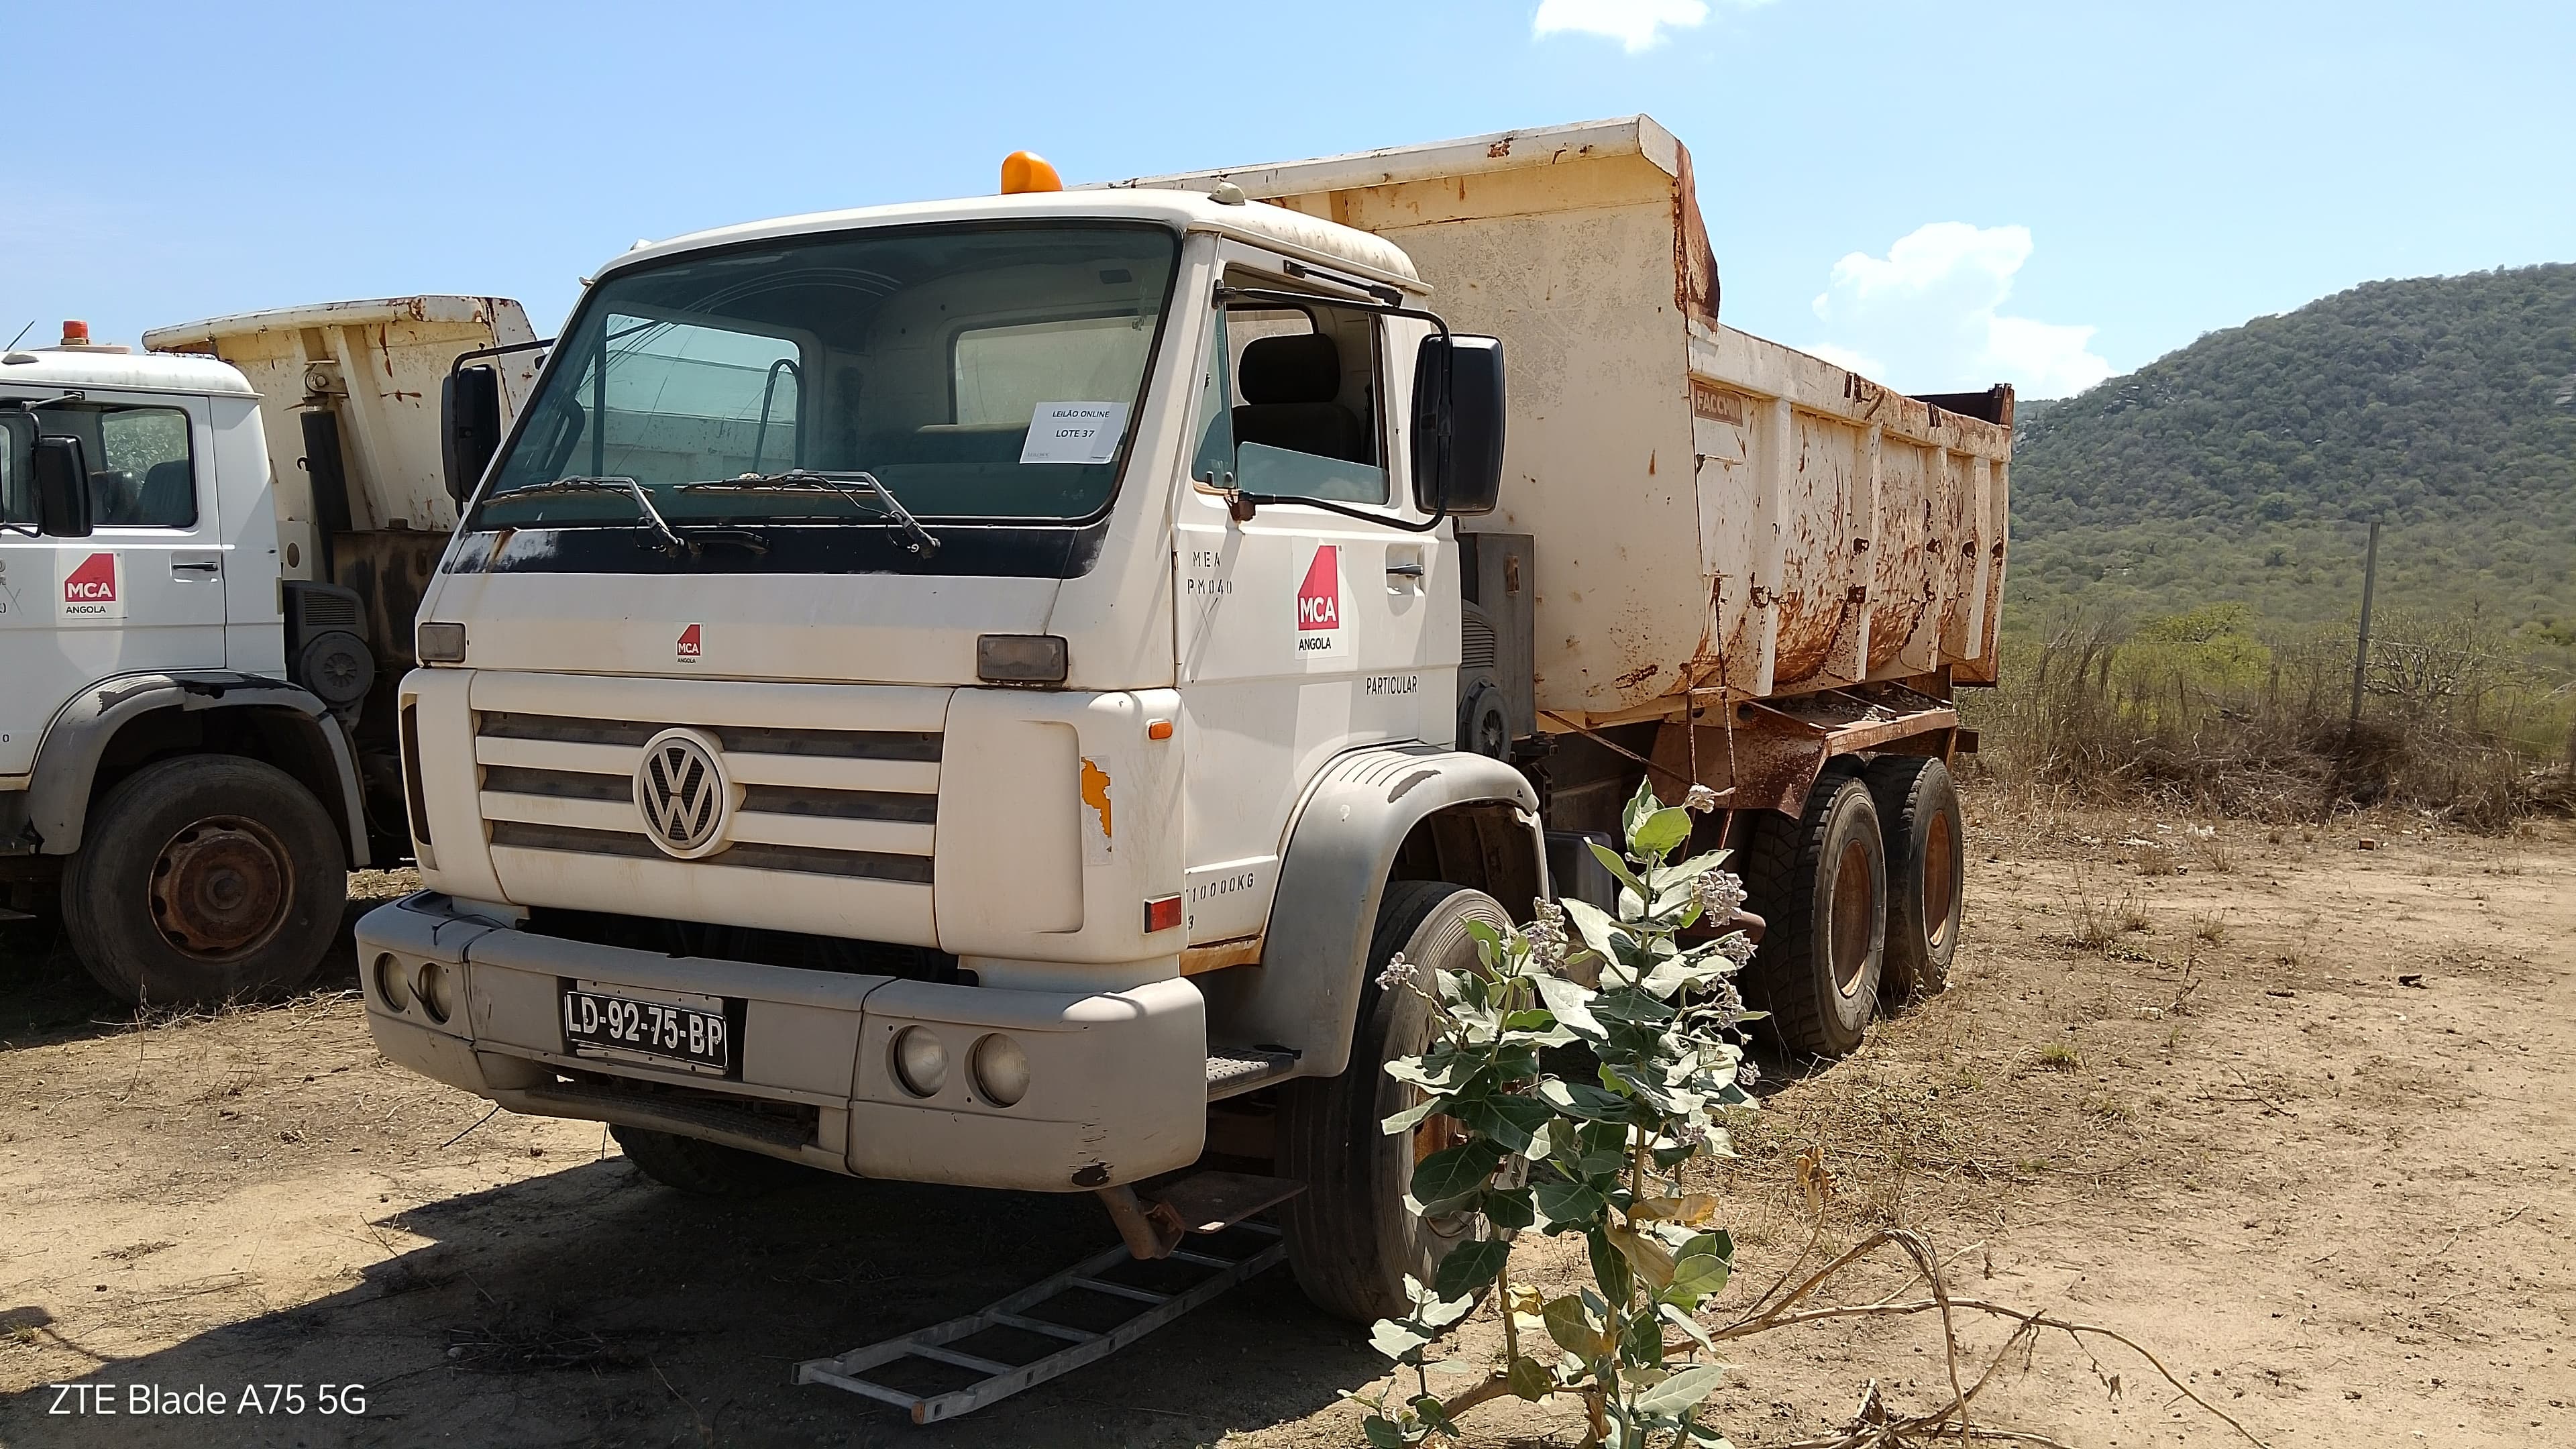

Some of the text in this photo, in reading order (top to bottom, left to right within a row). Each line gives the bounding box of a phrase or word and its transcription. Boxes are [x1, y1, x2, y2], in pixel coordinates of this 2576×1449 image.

[1052, 410, 1079, 418] LEILÃO
[1055, 429, 1095, 437] LOTE 37
[1193, 551, 1221, 568] MEA
[67, 582, 113, 598] MCA
[66, 606, 106, 614] ANGOLA
[1299, 596, 1337, 623] MCA
[678, 643, 699, 653] MCA
[1298, 637, 1332, 651] ANGOLA
[1366, 676, 1417, 696] PARTICULAR
[1186, 873, 1254, 903] 10000KG
[566, 994, 722, 1057] LD-92-75-BP
